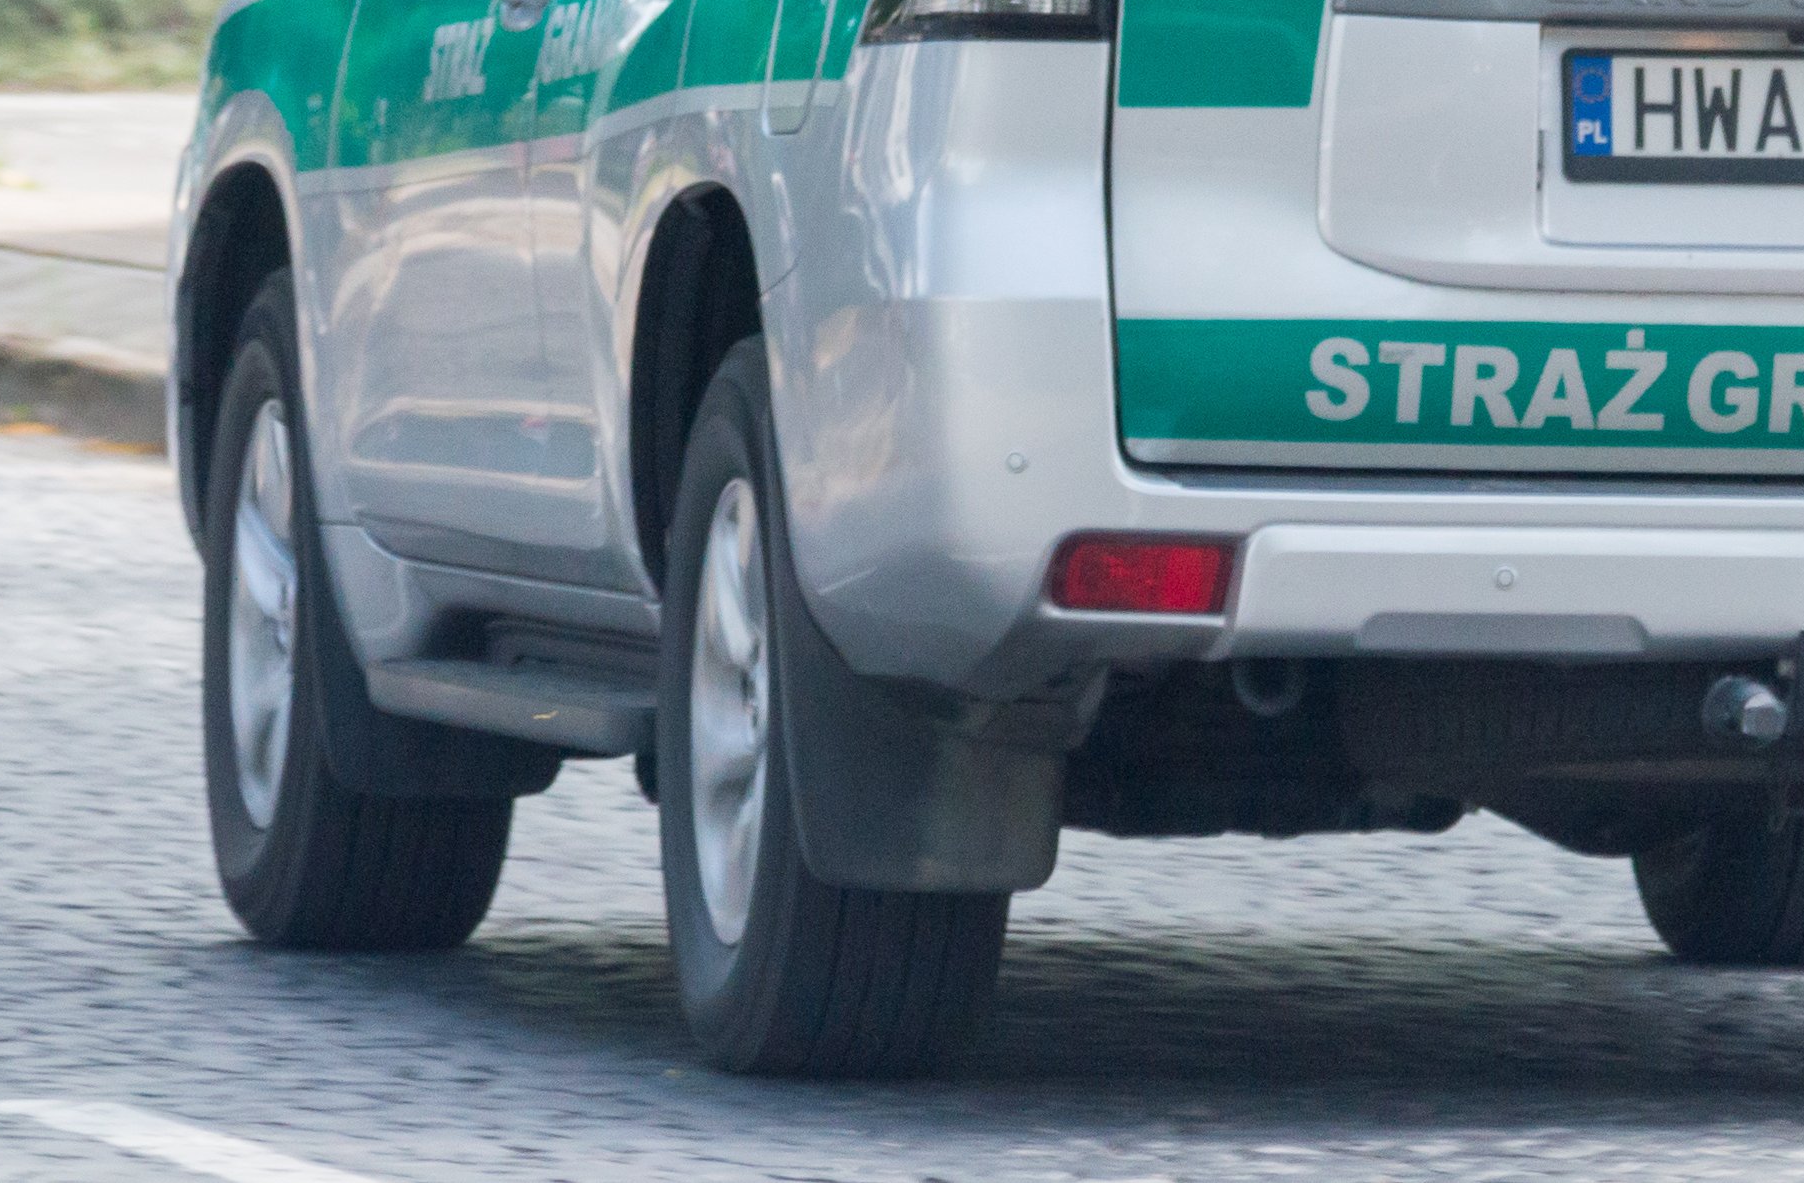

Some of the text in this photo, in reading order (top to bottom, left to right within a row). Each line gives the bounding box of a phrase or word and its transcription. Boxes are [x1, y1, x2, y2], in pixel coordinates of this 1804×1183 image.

[1577, 118, 1608, 144] PL
[1633, 66, 1803, 152] HWA
[1305, 329, 1668, 432] STRAŻ
